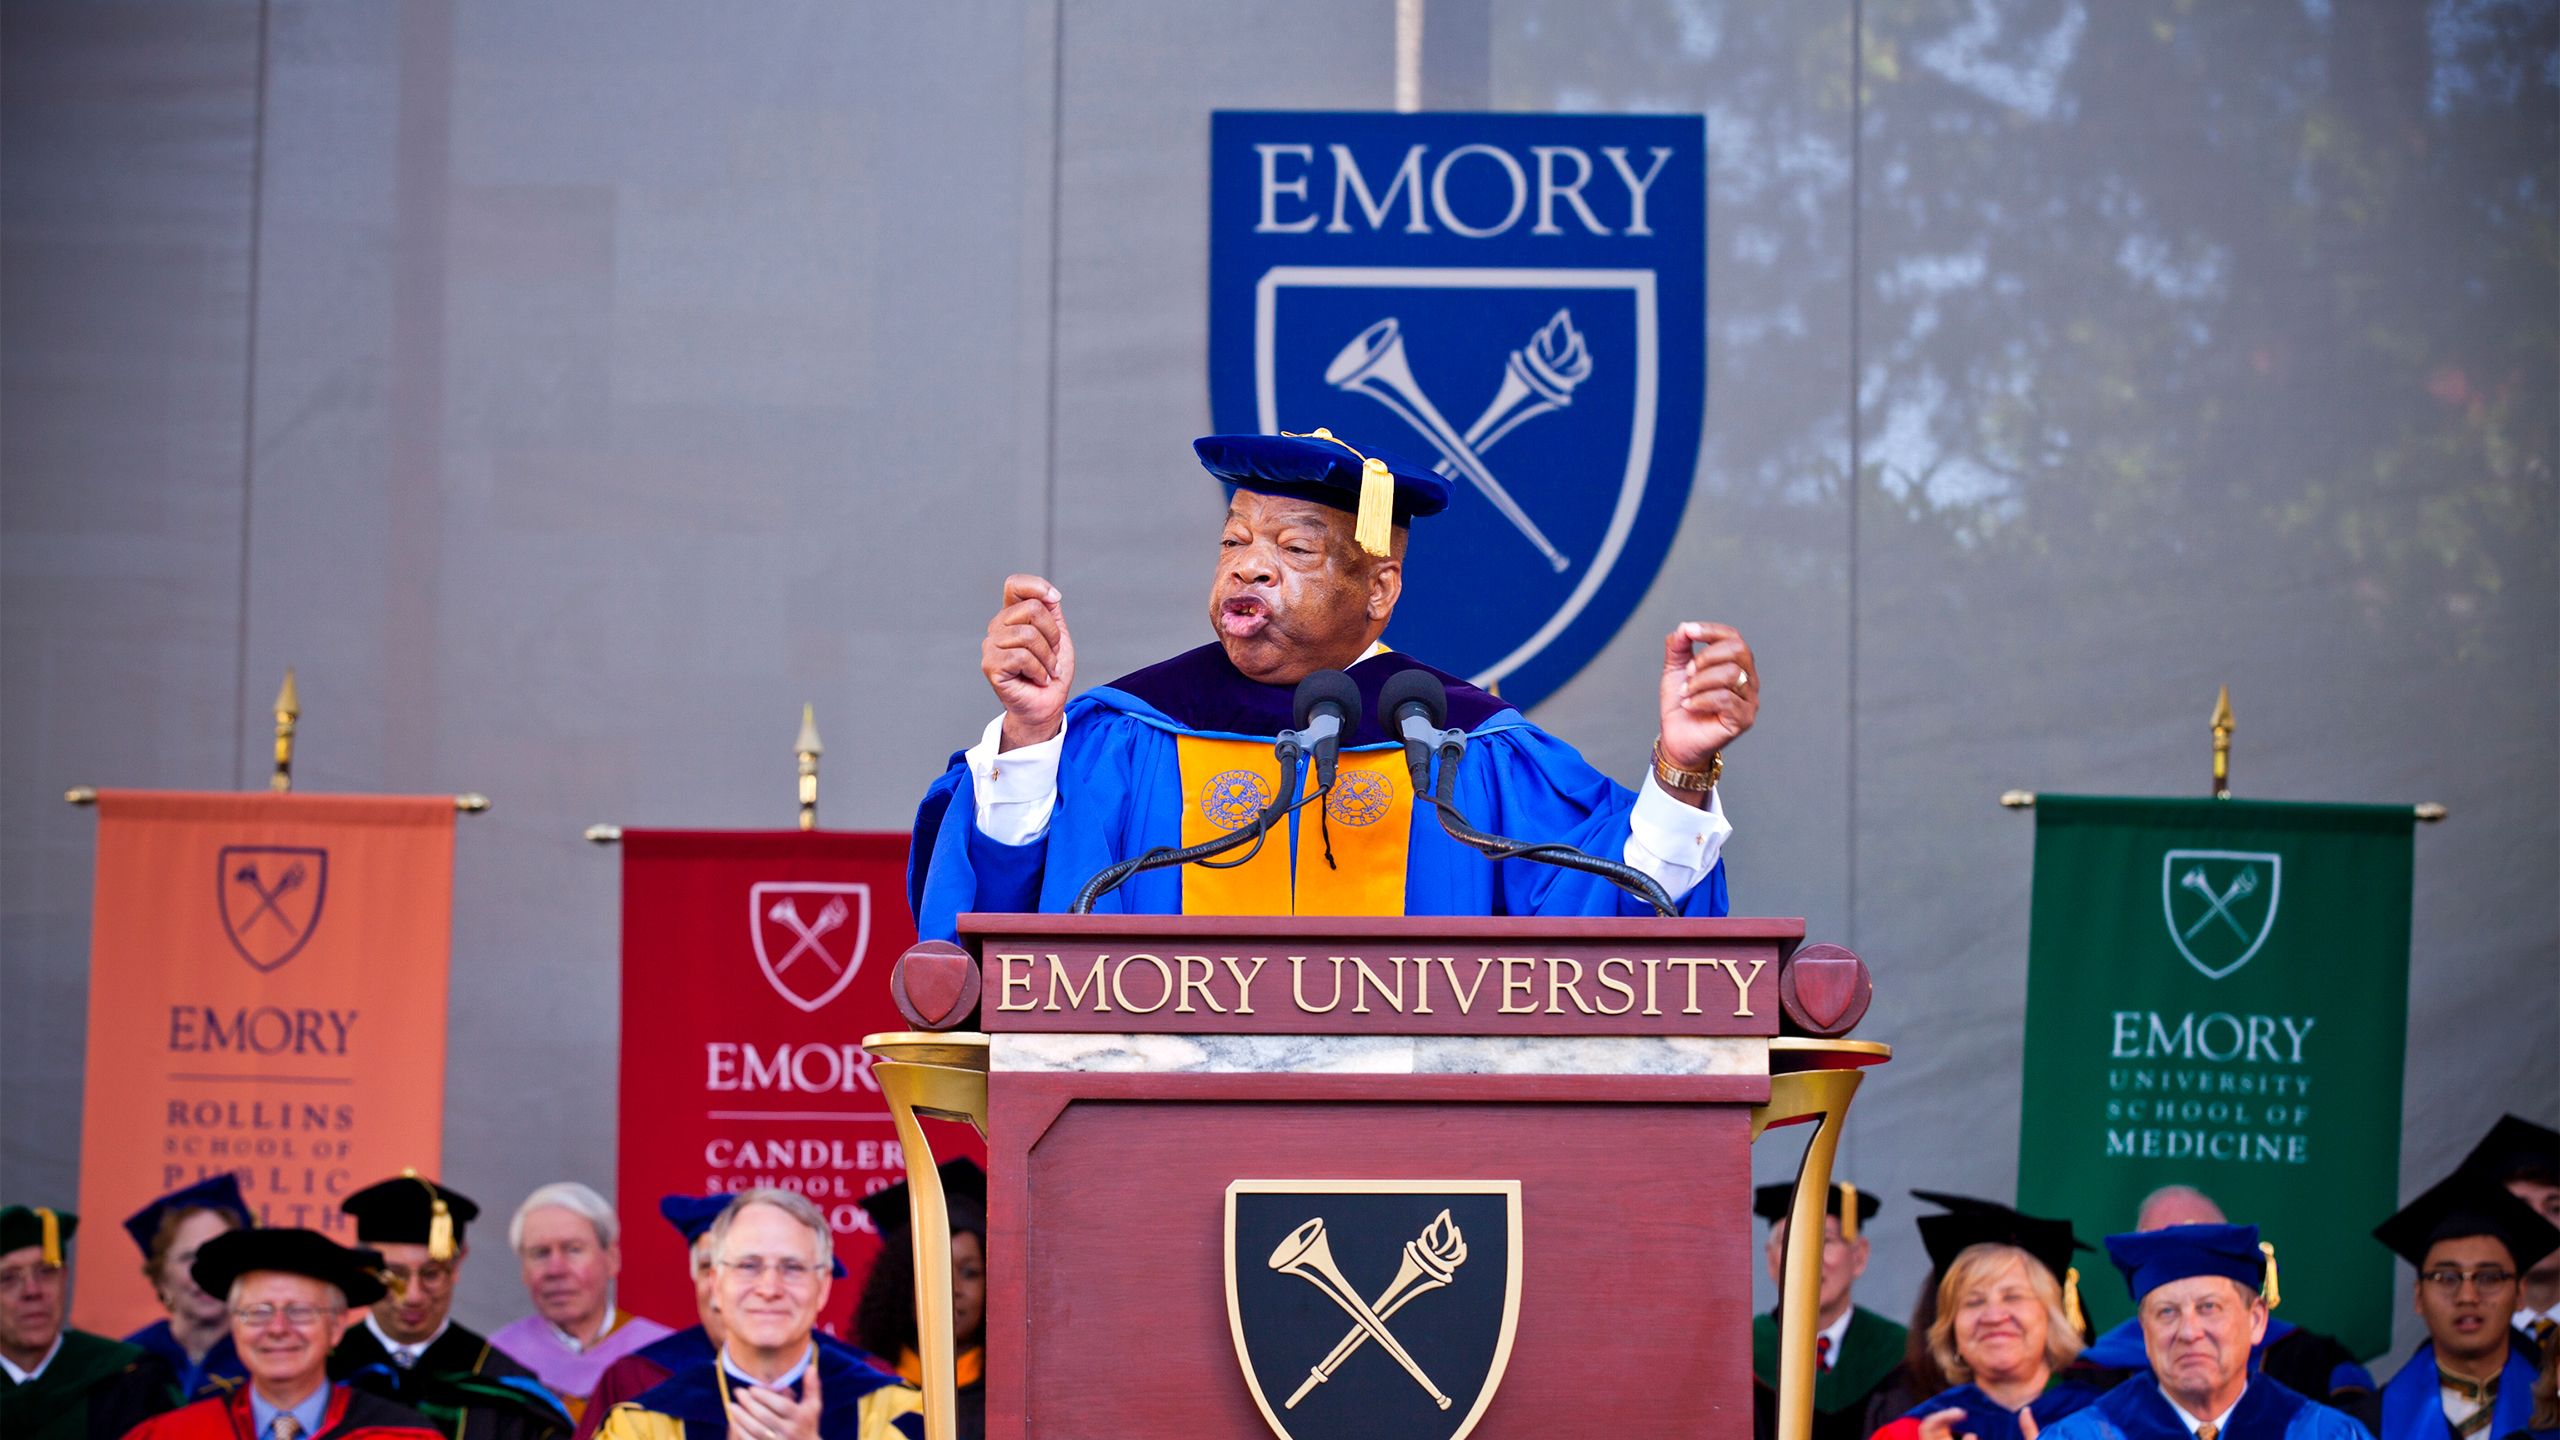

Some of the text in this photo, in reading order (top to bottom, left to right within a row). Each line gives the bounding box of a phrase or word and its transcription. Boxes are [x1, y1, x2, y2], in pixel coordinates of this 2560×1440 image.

[1254, 143, 1672, 238] EMORY
[996, 953, 1767, 1017] EMORY UNIVERSITY
[168, 1005, 359, 1056] EMORY
[2111, 1011, 2316, 1064] EMORY
[706, 1042, 895, 1094] EMOR
[2109, 1069, 2311, 1097] UNIVERSITY
[167, 1100, 353, 1131] ROLLINS
[2106, 1100, 2308, 1128] SCHOOL OF
[164, 1136, 351, 1161] SCHOOL OF
[705, 1138, 906, 1170] CANDLER
[2106, 1129, 2308, 1164] MEDICINE
[706, 1175, 907, 1197] SCHOOL O
